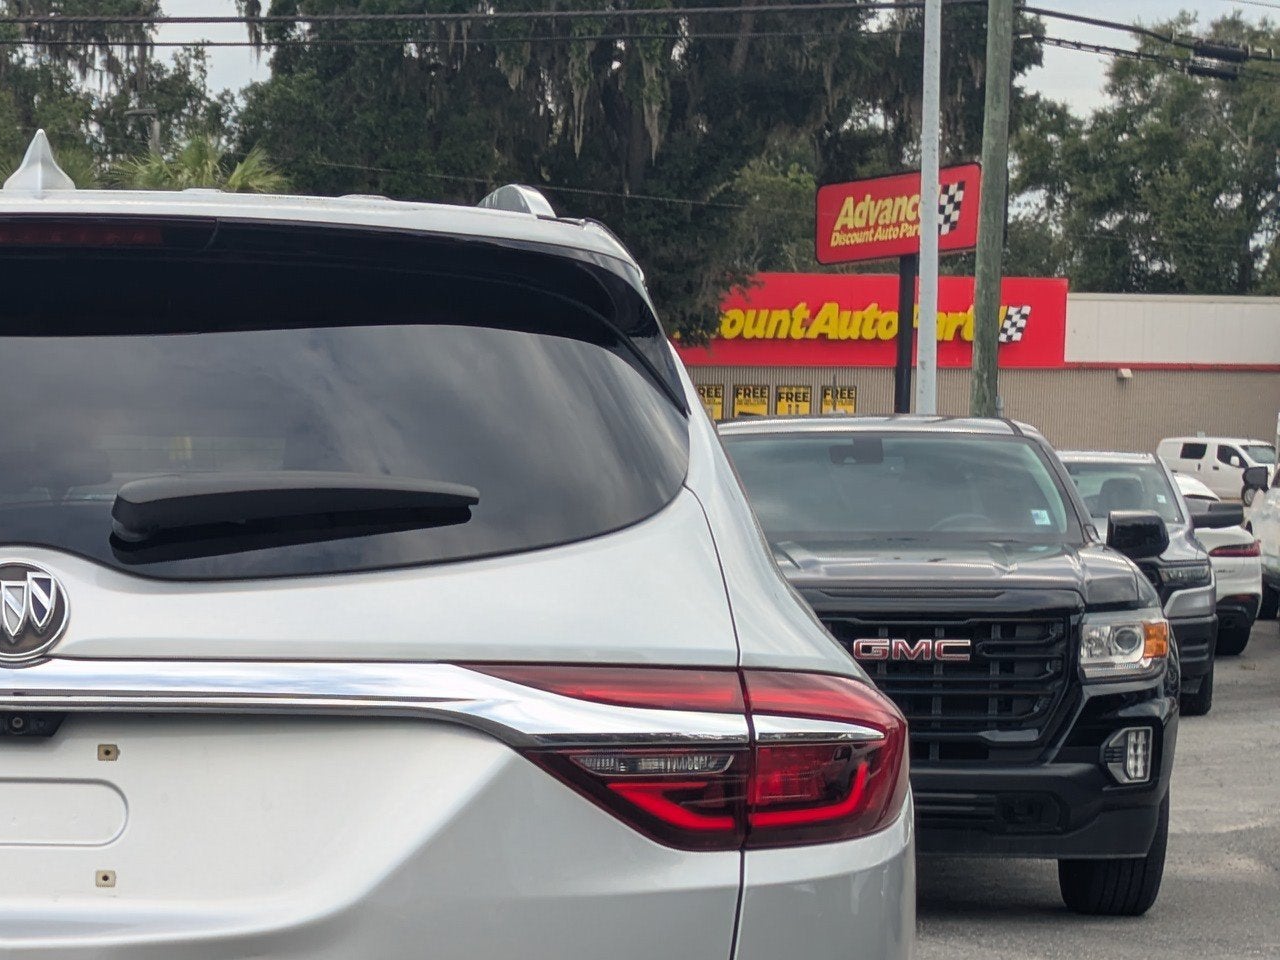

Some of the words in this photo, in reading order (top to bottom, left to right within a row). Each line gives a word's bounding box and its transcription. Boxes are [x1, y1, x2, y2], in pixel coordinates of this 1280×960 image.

[833, 194, 921, 230] Advanc
[830, 229, 874, 247] Discount
[874, 225, 900, 242] Auto
[805, 302, 899, 341] Auto
[697, 385, 722, 398] REE
[736, 386, 768, 399] FREE
[778, 391, 810, 402] FREE
[853, 638, 971, 661] GMC
